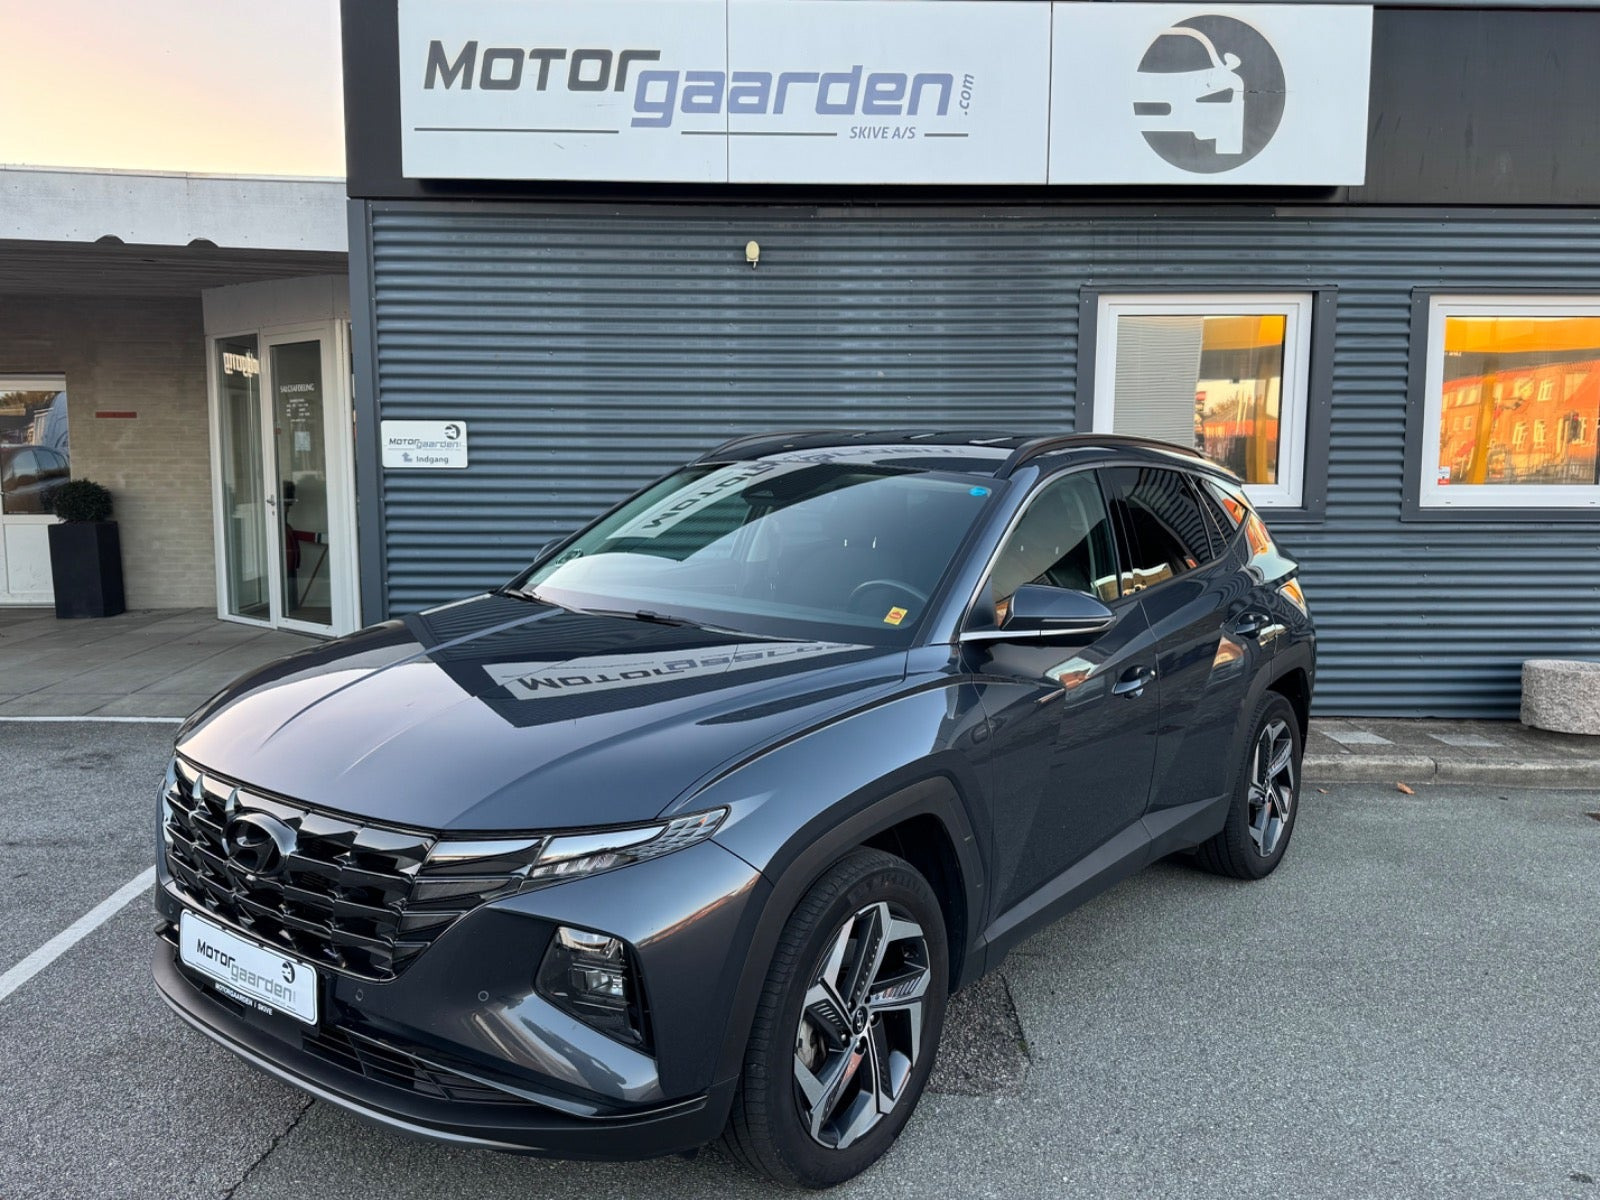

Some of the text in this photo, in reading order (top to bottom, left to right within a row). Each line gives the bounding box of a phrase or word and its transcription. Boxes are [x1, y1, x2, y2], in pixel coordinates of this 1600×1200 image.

[630, 65, 954, 128] gaarden
[959, 73, 975, 116] .com
[849, 126, 916, 139] SKIVE A/S
[416, 456, 449, 464] Indgang
[231, 963, 292, 1002] gaarden
